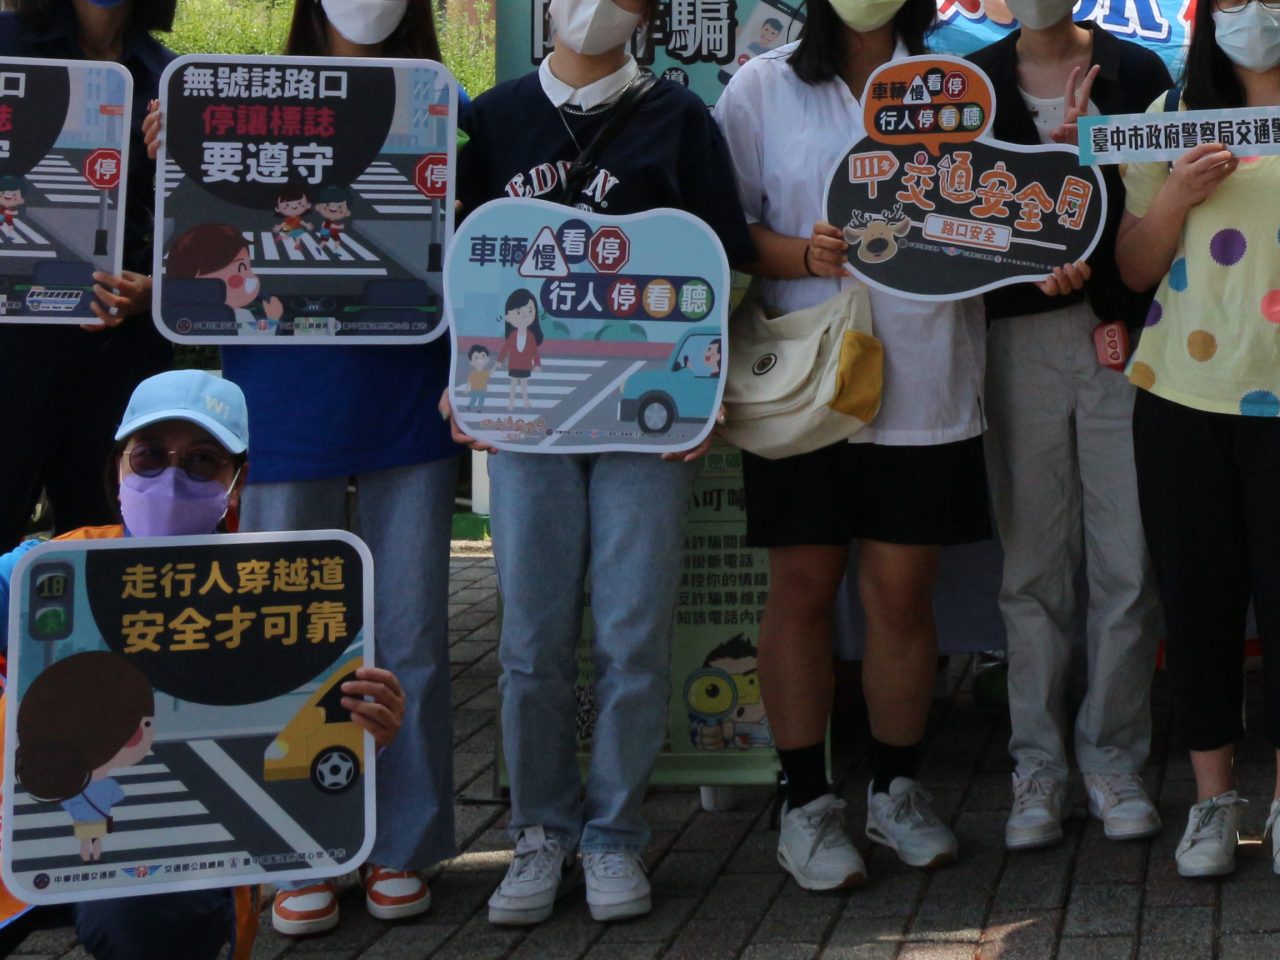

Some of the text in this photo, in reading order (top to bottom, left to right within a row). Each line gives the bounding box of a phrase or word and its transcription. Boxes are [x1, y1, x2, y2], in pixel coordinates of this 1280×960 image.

[183, 66, 348, 100] 無號誌路口
[202, 105, 335, 137] 停讓標誌
[880, 107, 981, 132] 行人停看聽
[94, 159, 117, 180] 停
[201, 142, 333, 184] 要遵守
[425, 164, 448, 188] 停
[941, 220, 997, 244] 路口安全
[549, 279, 708, 314] 行人停看聽
[121, 555, 345, 600] 走行人穿越道
[121, 601, 348, 654] 安全才可靠
